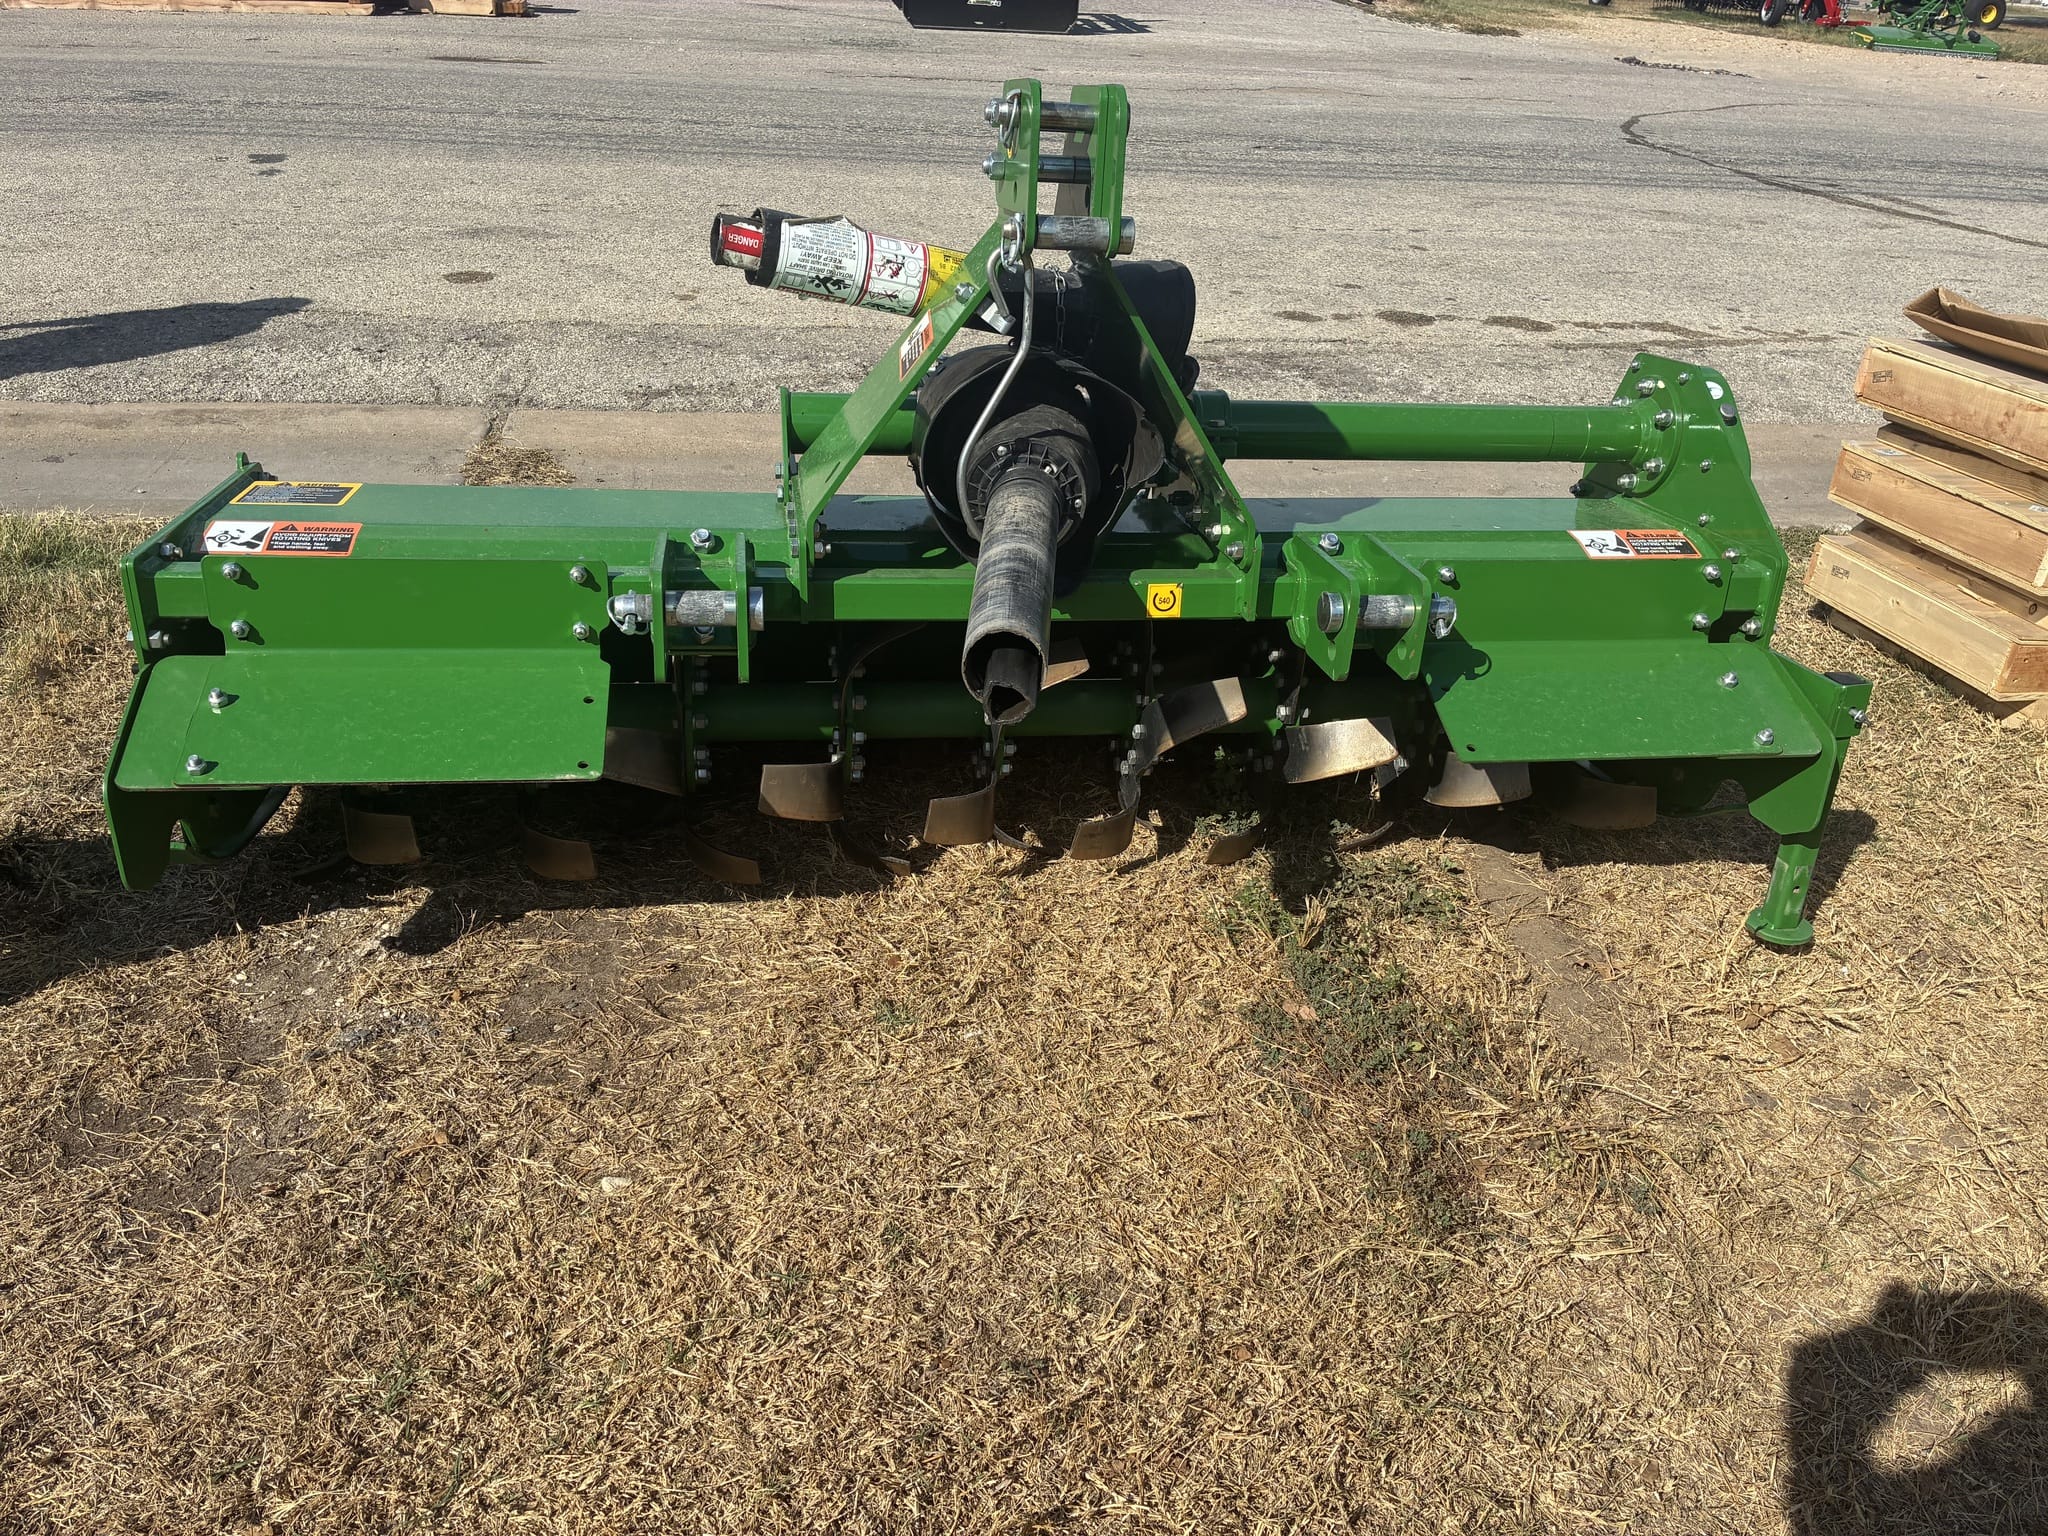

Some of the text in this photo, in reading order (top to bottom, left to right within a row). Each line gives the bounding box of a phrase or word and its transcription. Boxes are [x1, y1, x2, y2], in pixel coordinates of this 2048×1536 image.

[727, 233, 759, 248] DANGER
[815, 246, 837, 256] OPERATE
[800, 251, 842, 264] KEEP AWAY!
[788, 261, 807, 269] SHAFT
